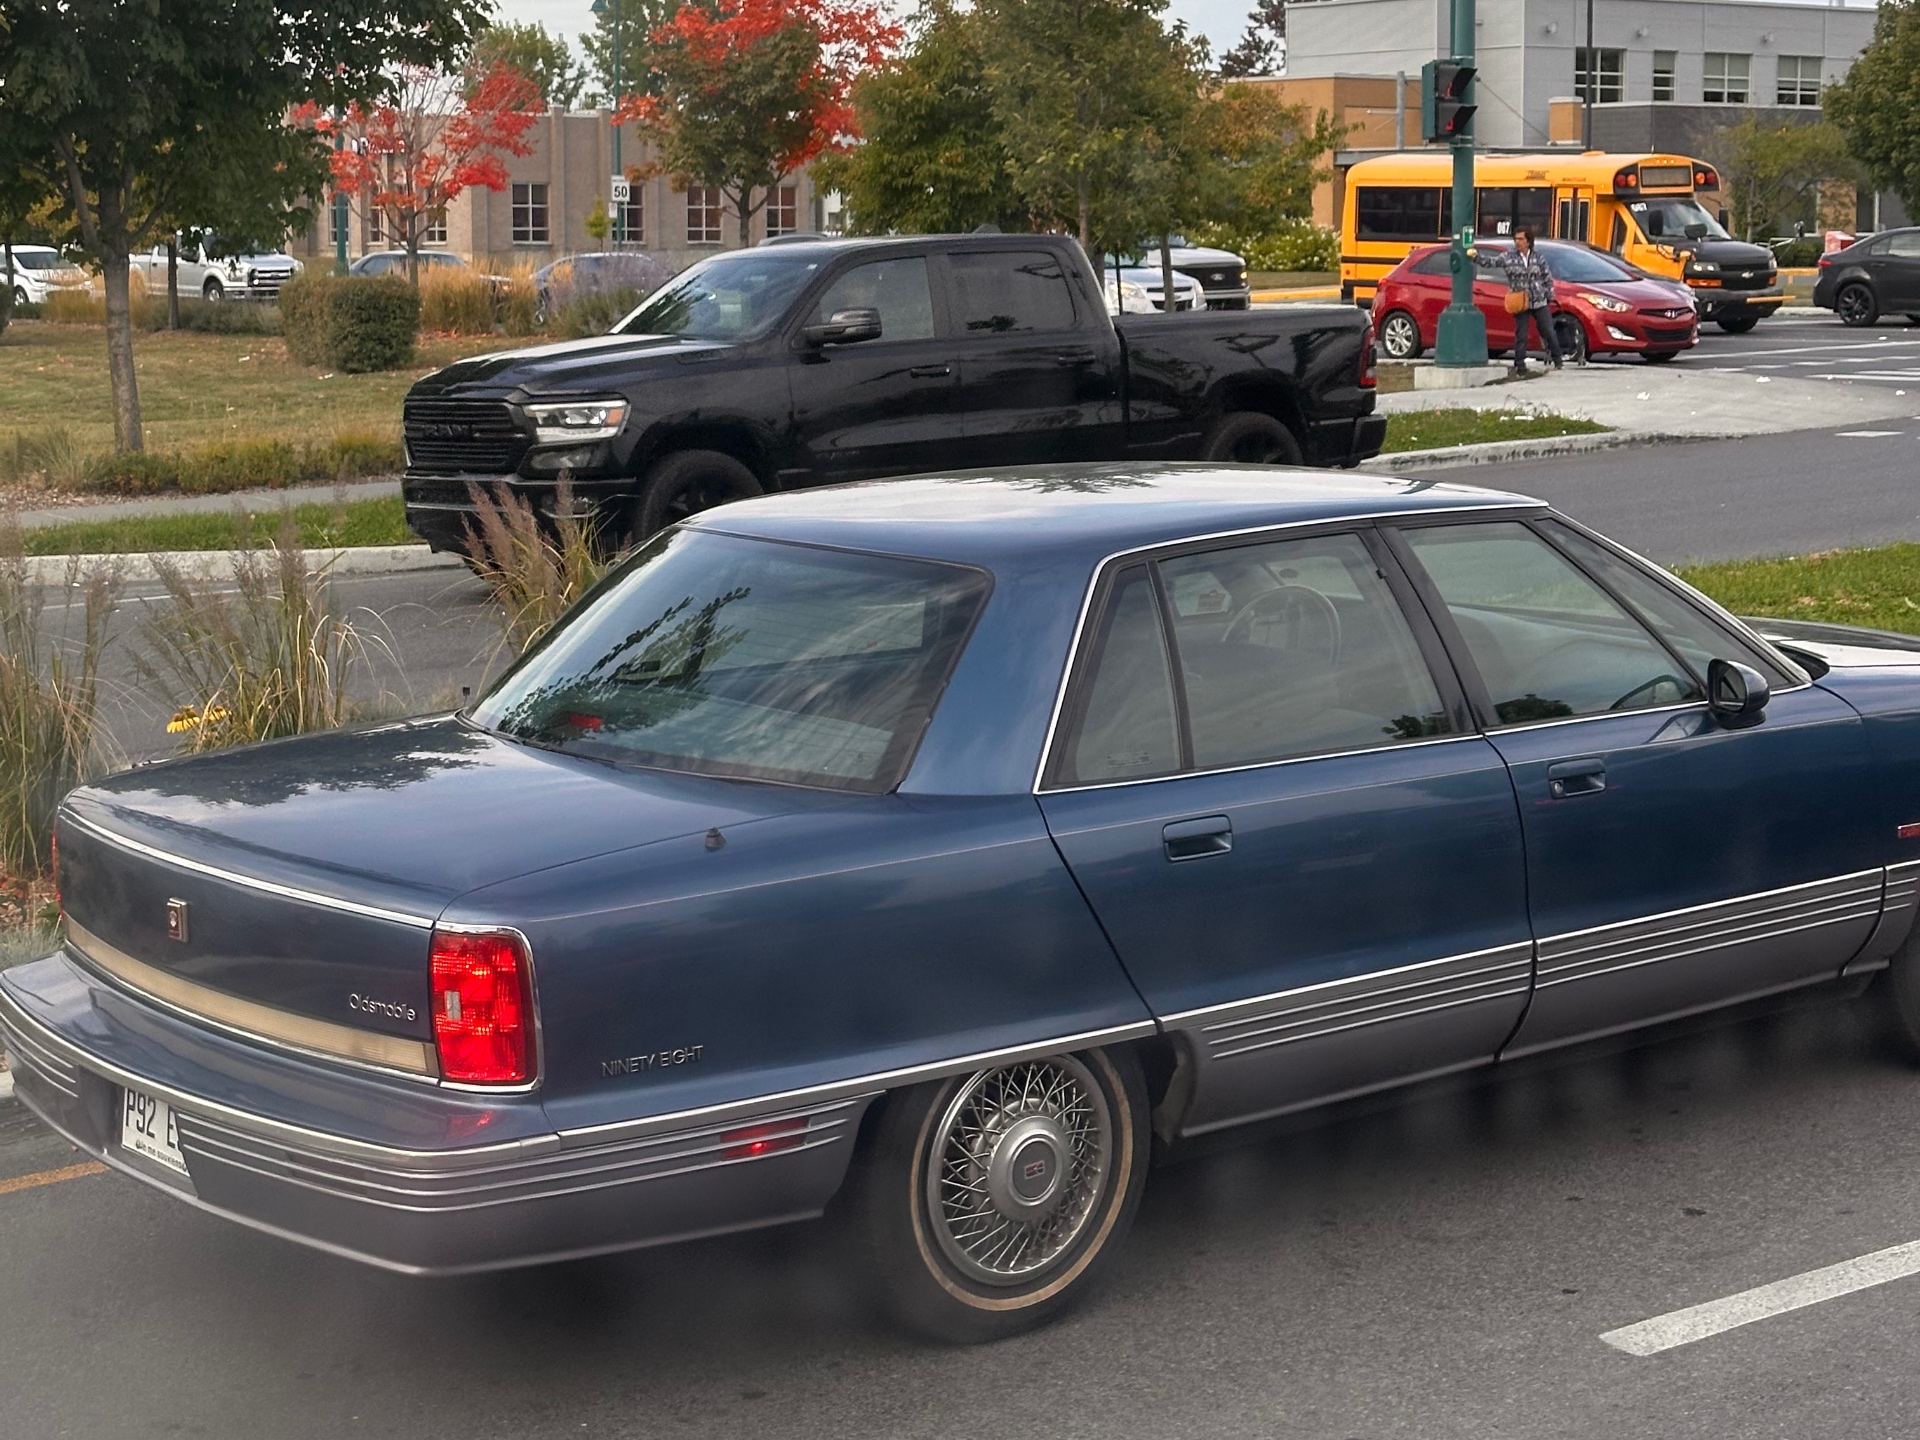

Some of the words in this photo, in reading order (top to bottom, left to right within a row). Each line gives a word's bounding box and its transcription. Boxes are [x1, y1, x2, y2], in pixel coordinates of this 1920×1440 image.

[614, 185, 628, 198] 50
[349, 993, 416, 1021] Oldsmobile
[601, 1054, 656, 1077] NINETY
[660, 1045, 704, 1067] EIGHT
[125, 1089, 156, 1139] P92
